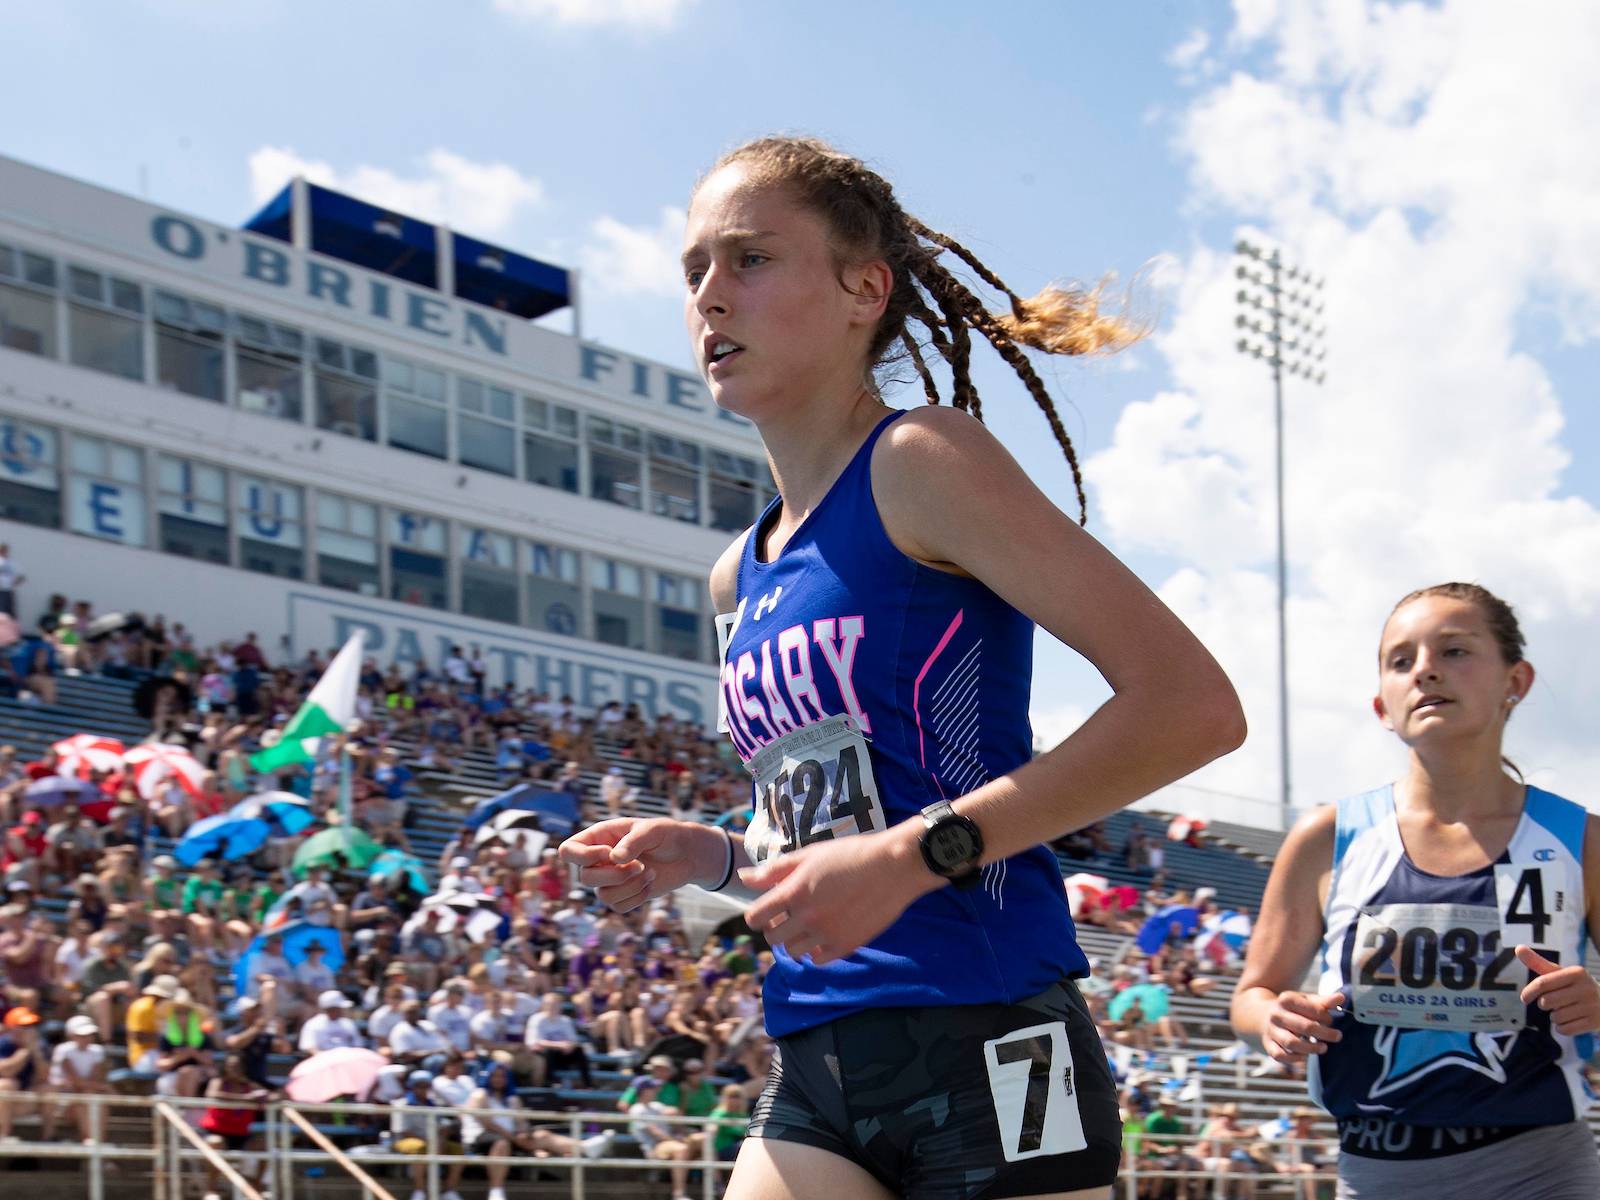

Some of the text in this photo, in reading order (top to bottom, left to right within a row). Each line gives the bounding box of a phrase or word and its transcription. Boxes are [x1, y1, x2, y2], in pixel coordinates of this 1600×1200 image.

[152, 216, 751, 427] O'BRIEN FIE
[1505, 868, 1552, 944] 4
[1360, 926, 1518, 991] 2032
[1378, 992, 1498, 1009] CLASS 2A GIRLS
[995, 1033, 1053, 1154] 7
[1342, 1118, 1416, 1153] PRO
